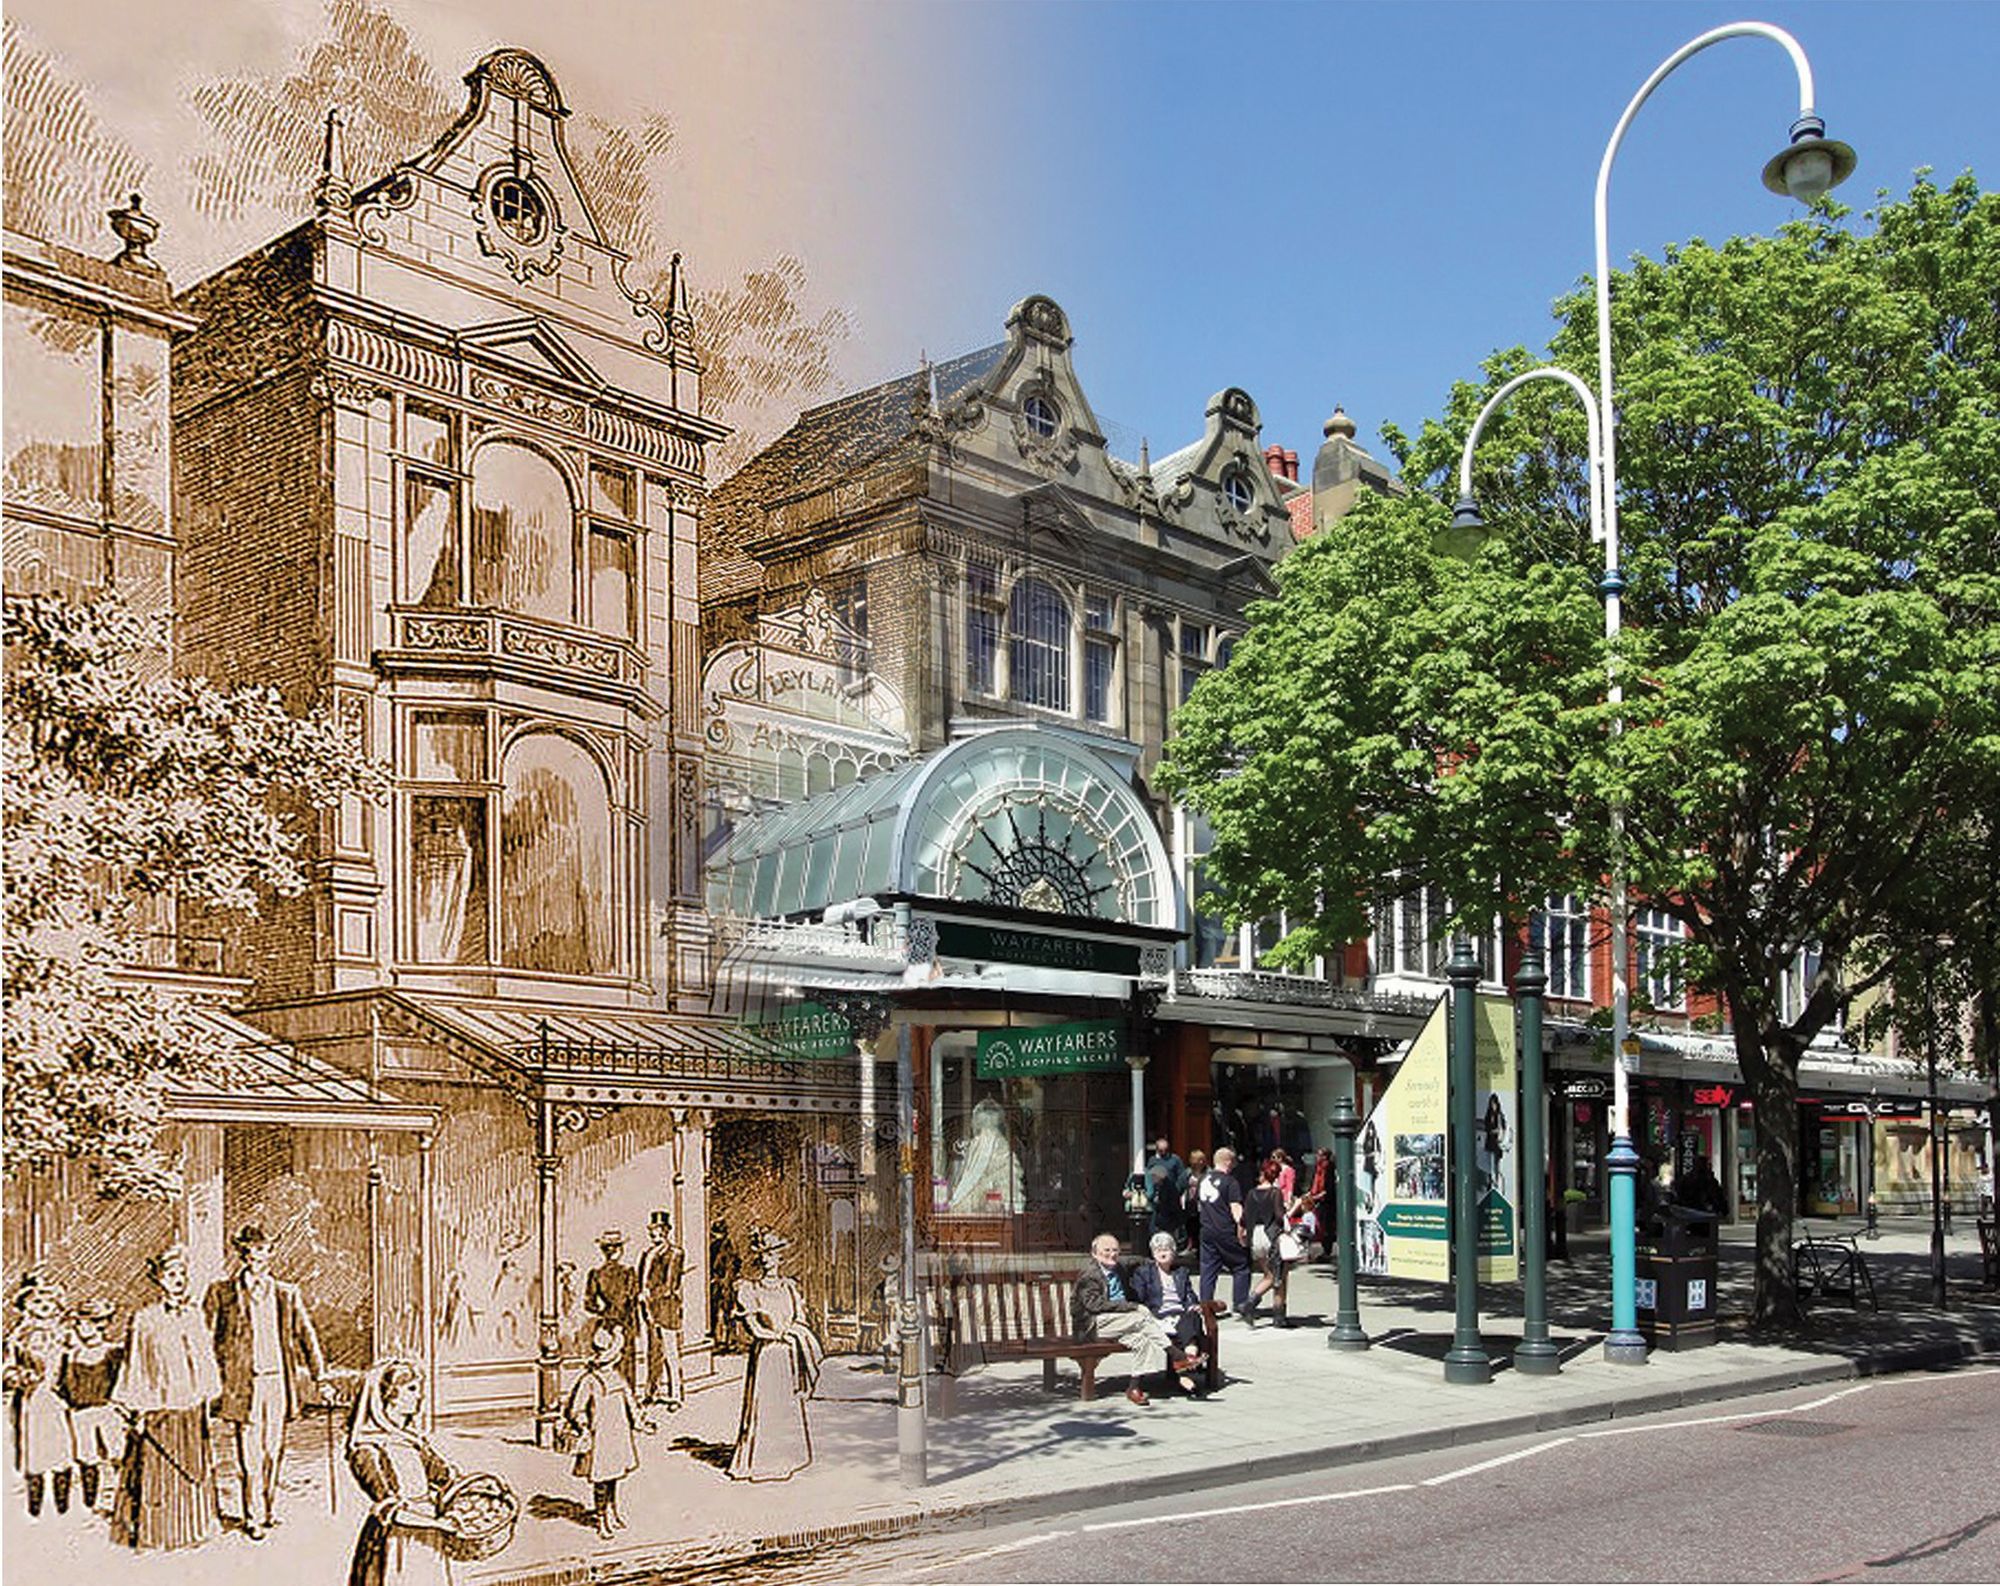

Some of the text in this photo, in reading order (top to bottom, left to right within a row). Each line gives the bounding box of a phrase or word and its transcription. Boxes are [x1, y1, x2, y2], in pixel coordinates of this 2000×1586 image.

[990, 932, 1094, 955] WAYFARERS
[1018, 1030, 1118, 1053] WAYFARERS
[1020, 1053, 1118, 1067] SHOPPING ARCADE
